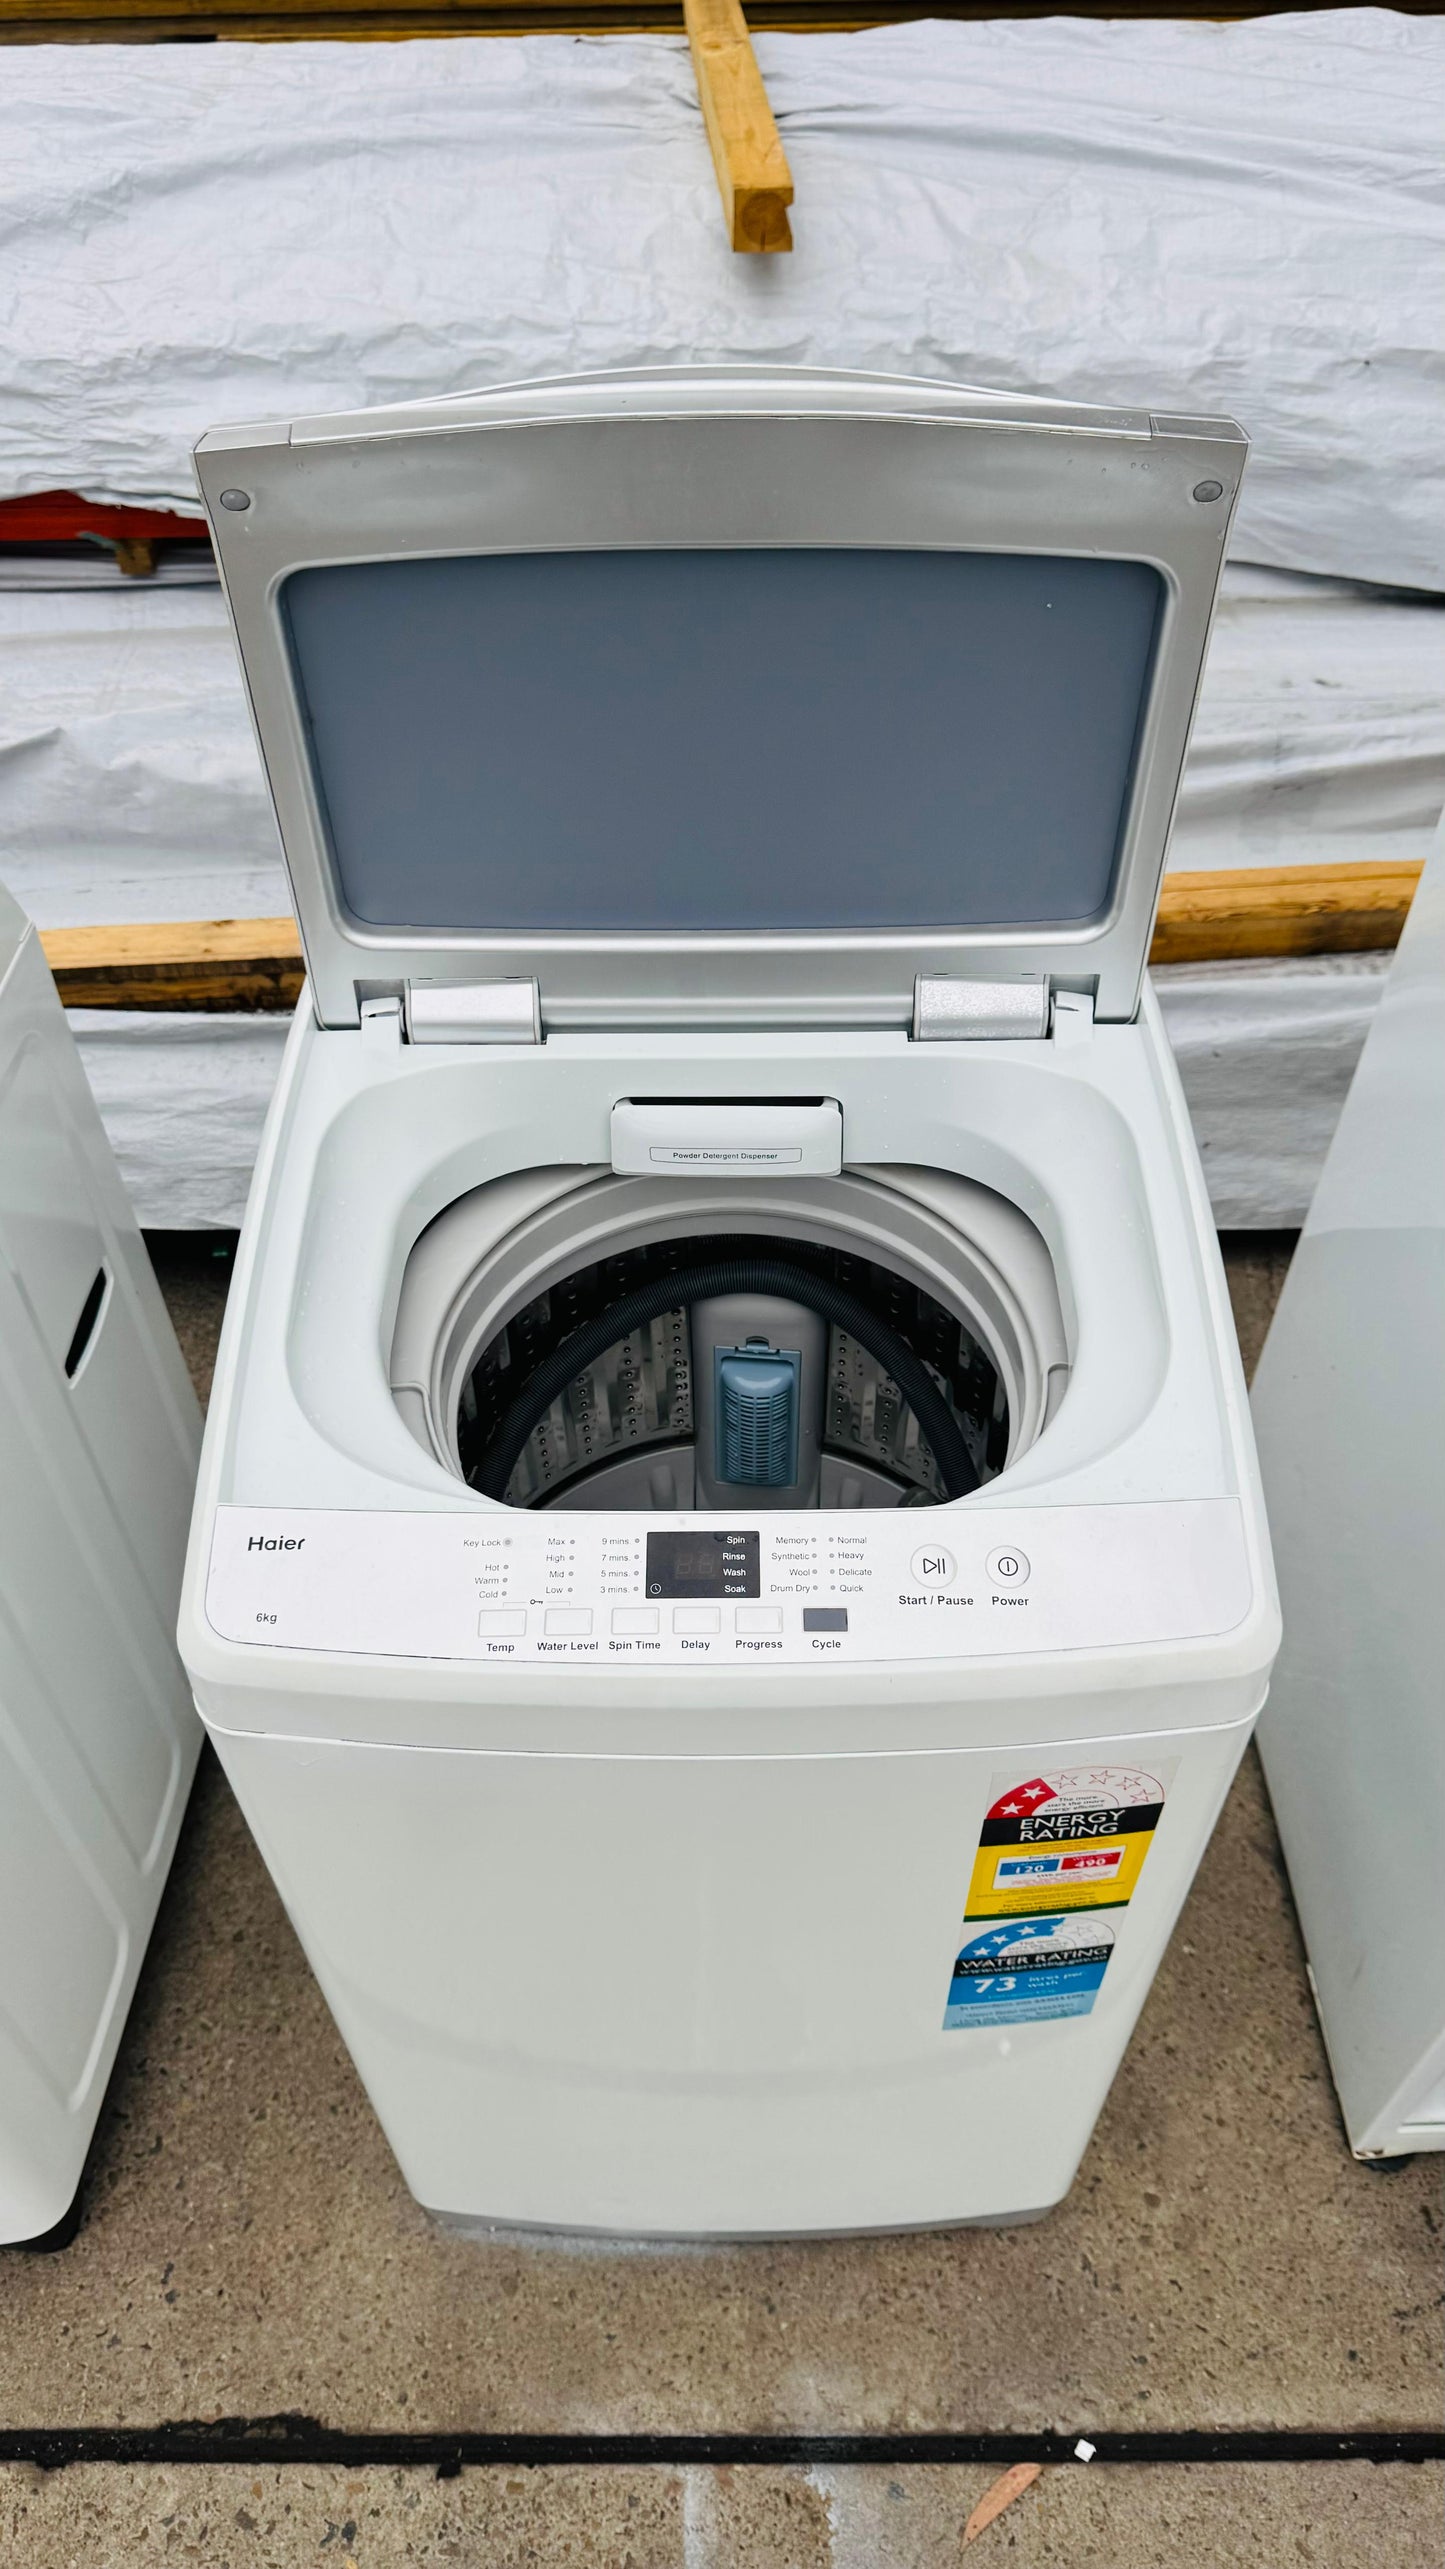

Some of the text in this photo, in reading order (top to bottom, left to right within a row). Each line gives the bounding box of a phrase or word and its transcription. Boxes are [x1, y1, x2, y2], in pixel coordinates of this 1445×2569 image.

[703, 1152, 739, 1161] Detergent
[741, 1152, 778, 1161] Dispenser
[247, 1535, 305, 1551] Haier
[463, 1539, 479, 1548] Key
[726, 1536, 745, 1545] Spin
[776, 1536, 809, 1546] Memory
[546, 1554, 565, 1563] High
[601, 1554, 607, 1562] 7
[722, 1553, 746, 1561] Rinse
[771, 1552, 810, 1561] Synthetic
[838, 1551, 864, 1561] Heavy
[485, 1563, 500, 1571] Hot
[789, 1568, 810, 1576] Wool
[839, 1568, 872, 1576] Delicate
[601, 1570, 606, 1578] 5
[724, 1585, 746, 1593] Soak
[770, 1584, 810, 1594] Drum Dry
[839, 1584, 864, 1592] Quick
[479, 1590, 498, 1598] Cold
[899, 1595, 927, 1605] Start
[937, 1596, 974, 1606] Pause
[991, 1596, 1029, 1606] Power
[256, 1613, 277, 1625] 6kg
[486, 1643, 515, 1654] Temp
[537, 1642, 598, 1651] Water Level
[609, 1641, 661, 1651] Spin Time
[681, 1640, 710, 1651] Delay
[735, 1640, 783, 1650] Progress
[812, 1640, 841, 1650] Cycle
[1020, 1810, 1126, 1830] ENERGY
[1020, 1823, 1119, 1841] RATING
[1075, 1858, 1106, 1868] 490
[1015, 1865, 1044, 1874] 120
[962, 1953, 1029, 1969] WATER
[1035, 1947, 1108, 1963] RATING
[974, 1976, 1017, 1994] 73
